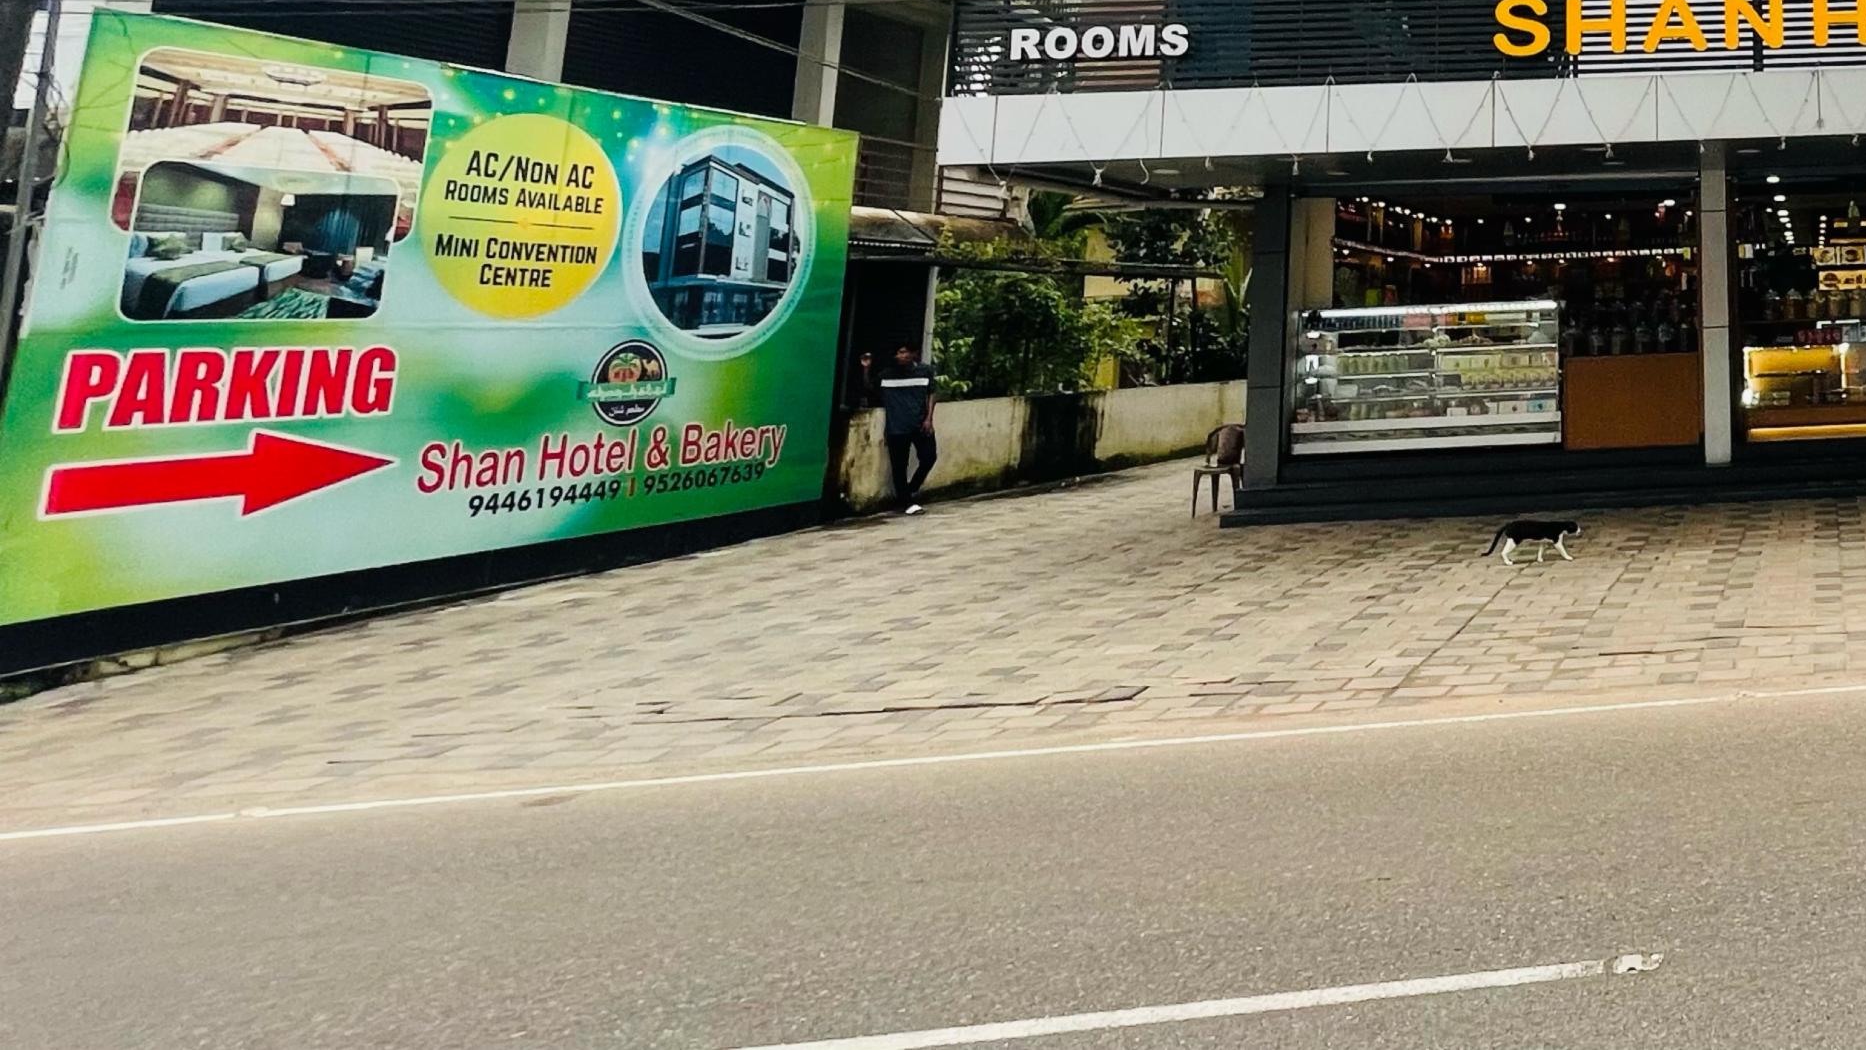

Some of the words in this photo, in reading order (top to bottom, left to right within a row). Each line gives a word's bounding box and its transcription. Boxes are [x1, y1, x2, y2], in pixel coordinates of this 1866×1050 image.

[1009, 24, 1190, 62] ROOMS
[566, 163, 595, 189] AC
[444, 180, 509, 205] ROOMS
[515, 188, 604, 214] AVAILABLE
[435, 233, 479, 258] MINI
[486, 238, 597, 264] CONVENTION
[479, 264, 553, 288] CENTRE
[55, 346, 398, 432] PARKING
[416, 441, 525, 494] Shan
[538, 426, 637, 482] Hotel
[645, 426, 671, 469] &
[681, 419, 787, 468] Bakery
[469, 479, 620, 518] 9446194449
[643, 461, 766, 496] 9526067639
